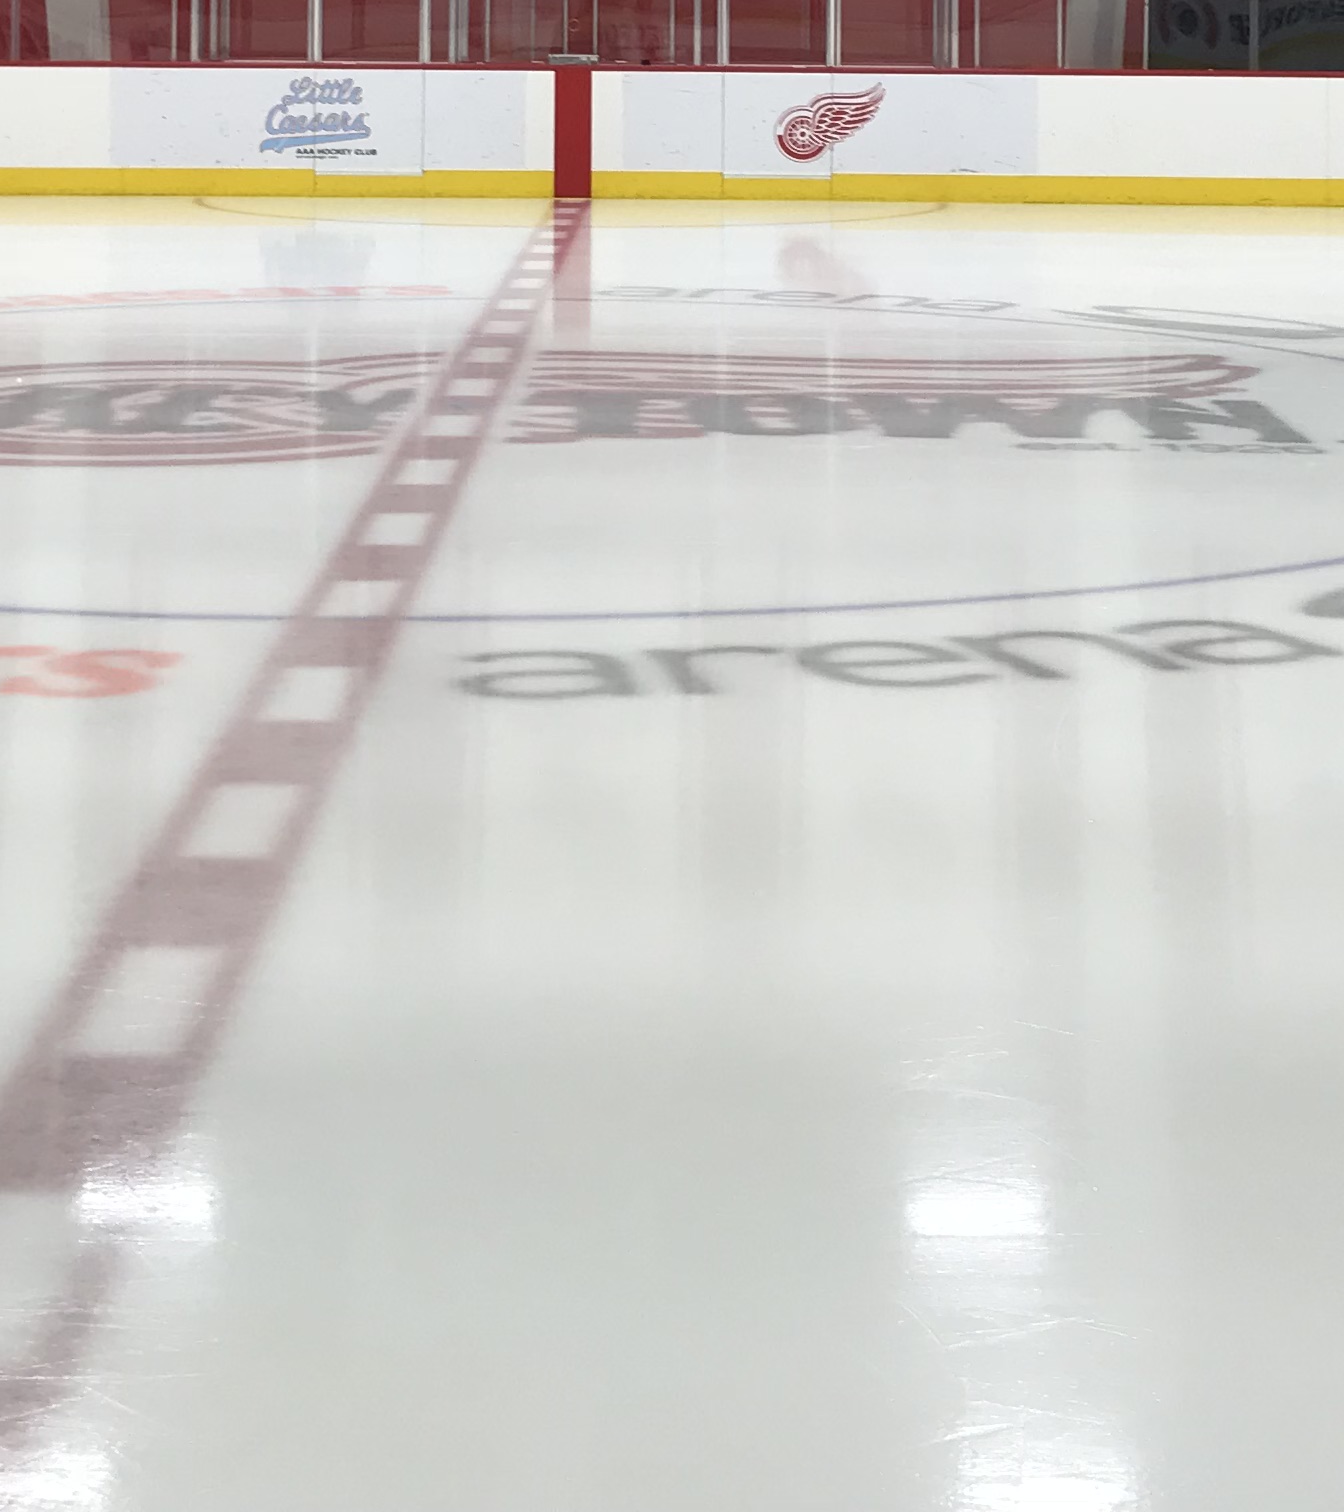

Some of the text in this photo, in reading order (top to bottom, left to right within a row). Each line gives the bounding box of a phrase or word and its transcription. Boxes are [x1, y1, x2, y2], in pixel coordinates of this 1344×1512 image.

[281, 76, 364, 105] Little
[265, 103, 372, 136] Caesars
[594, 283, 1018, 313] arena
